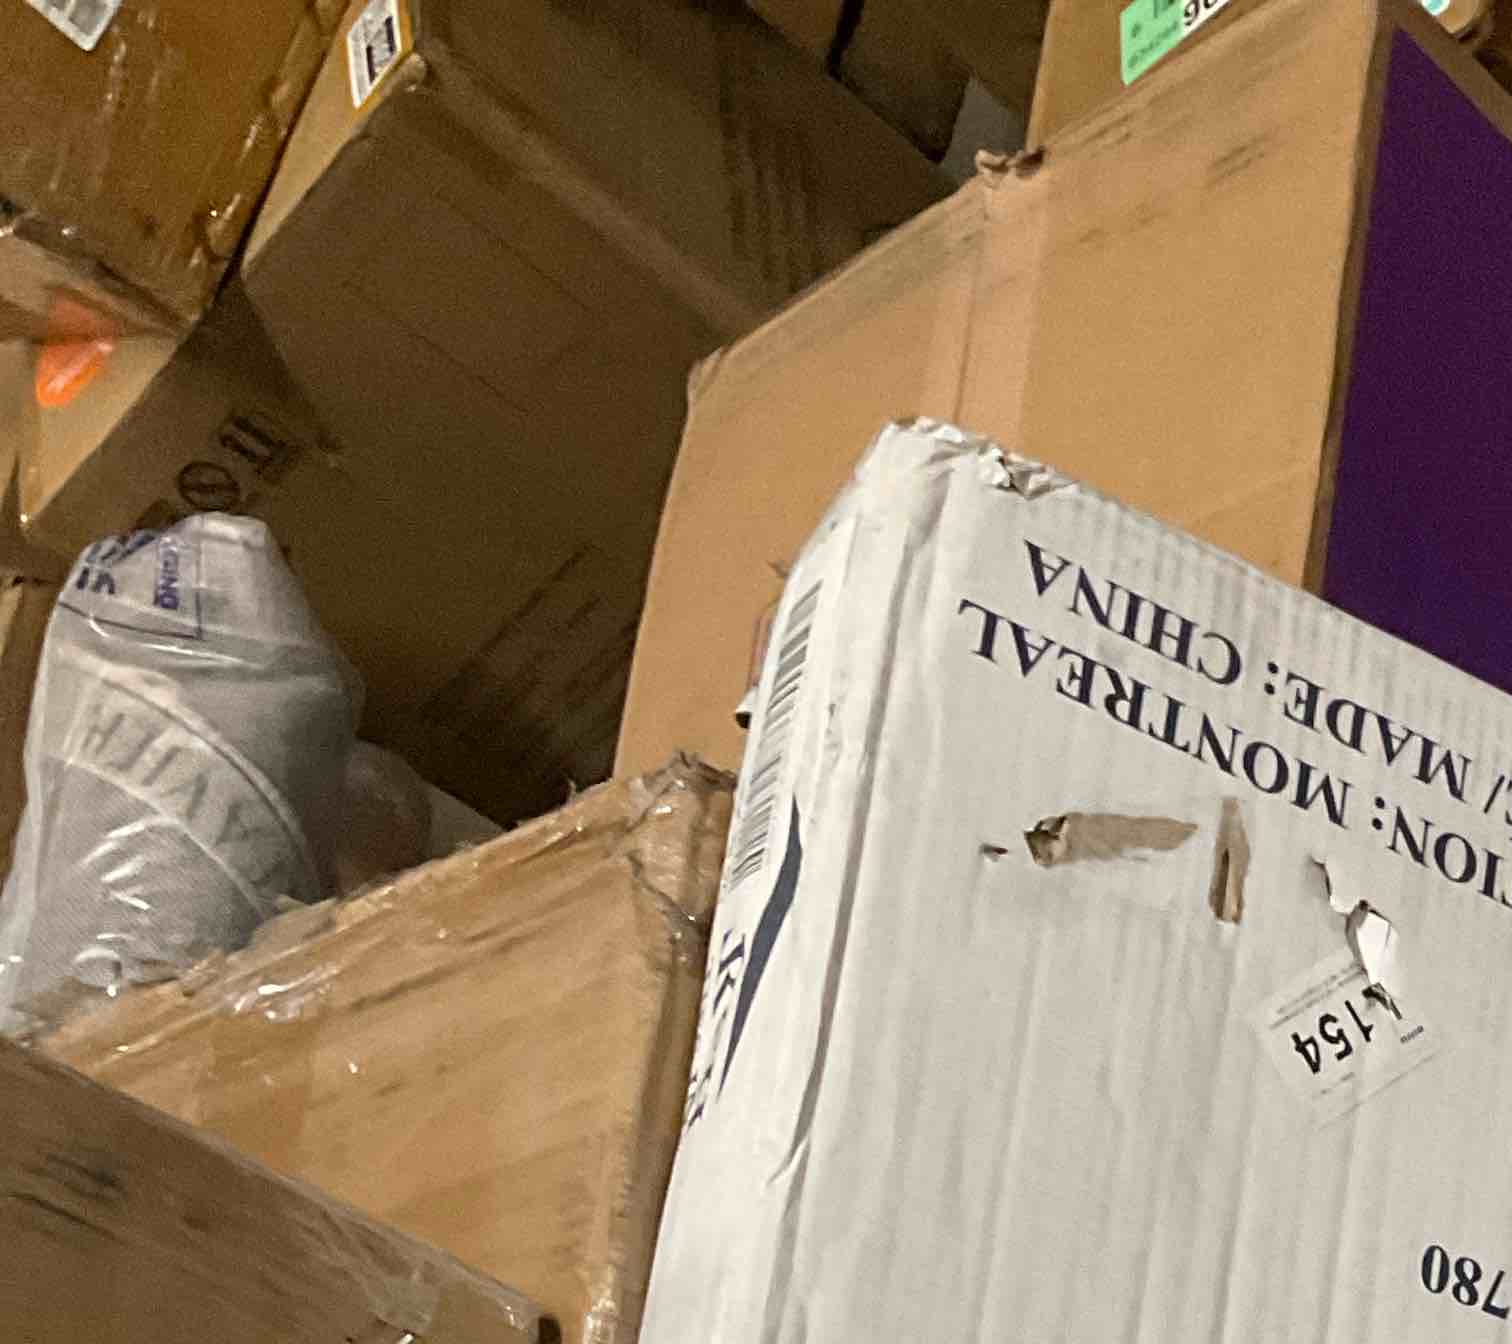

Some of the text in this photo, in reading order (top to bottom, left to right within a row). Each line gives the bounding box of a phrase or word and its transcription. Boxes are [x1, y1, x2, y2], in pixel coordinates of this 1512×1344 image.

[1022, 537, 1243, 687] CHINA
[957, 599, 1349, 826] MONTREAL
[1262, 661, 1471, 800] MADE:
